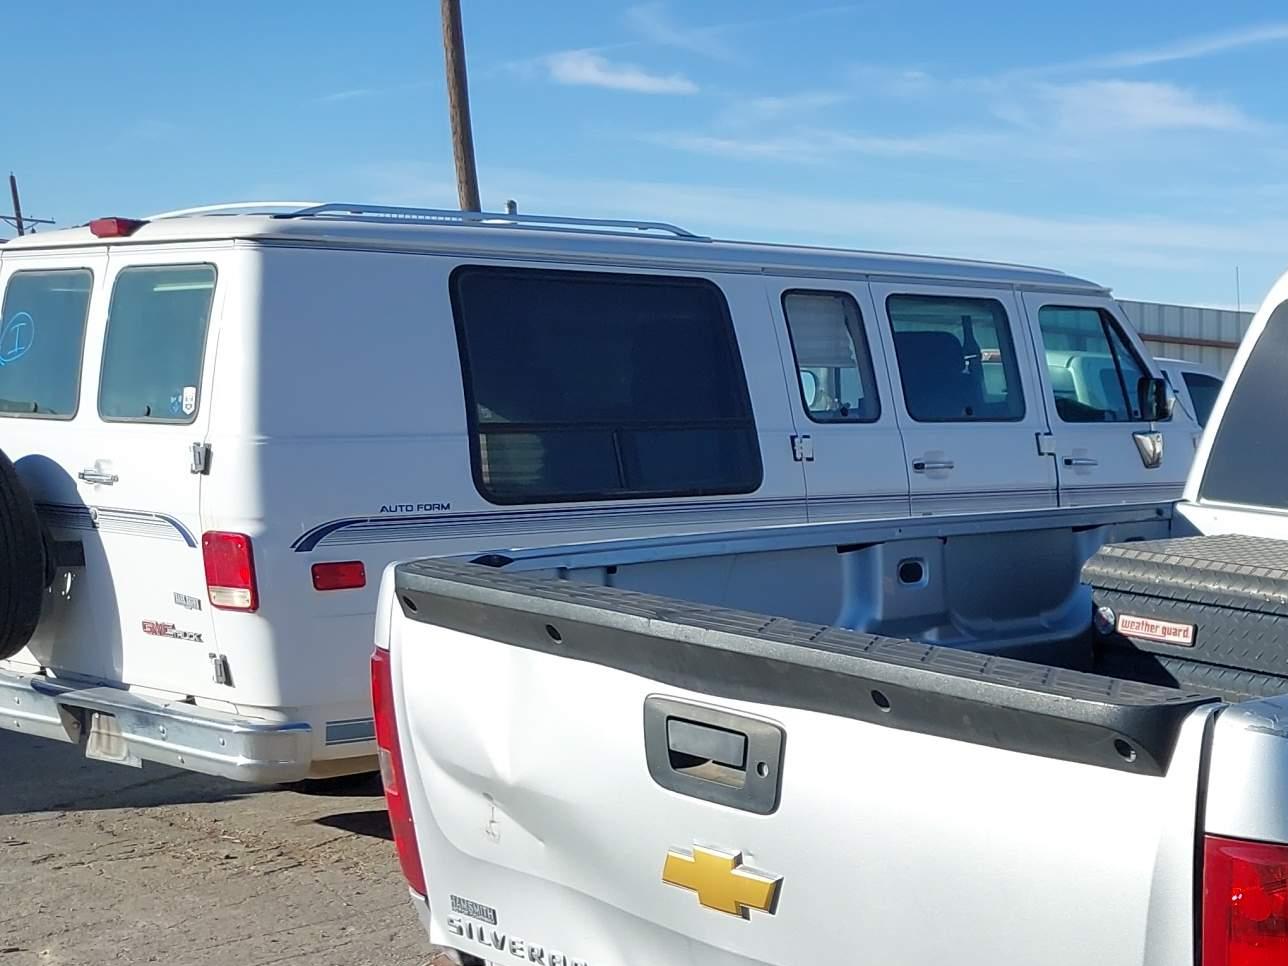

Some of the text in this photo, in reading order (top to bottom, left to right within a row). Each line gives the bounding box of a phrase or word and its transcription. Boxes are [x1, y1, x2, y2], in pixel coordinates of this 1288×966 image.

[379, 503, 451, 513] AUTO FORM
[142, 619, 176, 637] GMC
[1121, 618, 1190, 639] weather guard
